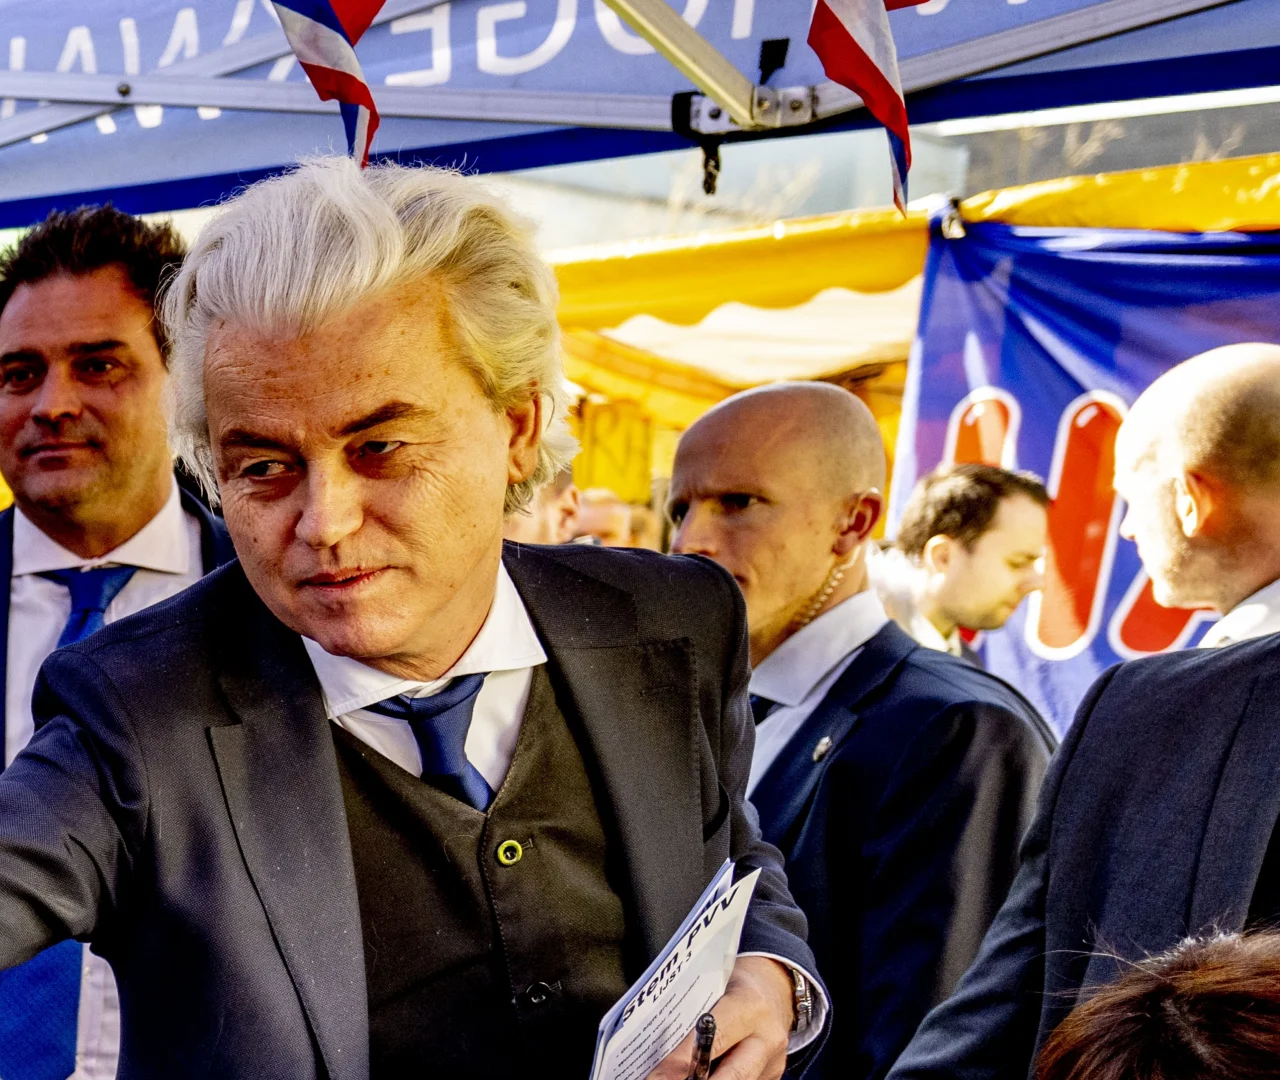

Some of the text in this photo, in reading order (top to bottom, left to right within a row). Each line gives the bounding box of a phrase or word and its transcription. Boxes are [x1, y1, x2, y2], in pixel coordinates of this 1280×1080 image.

[623, 952, 679, 1022] Stem
[686, 885, 740, 949] PVV
[653, 951, 692, 1003] LIJST 3
